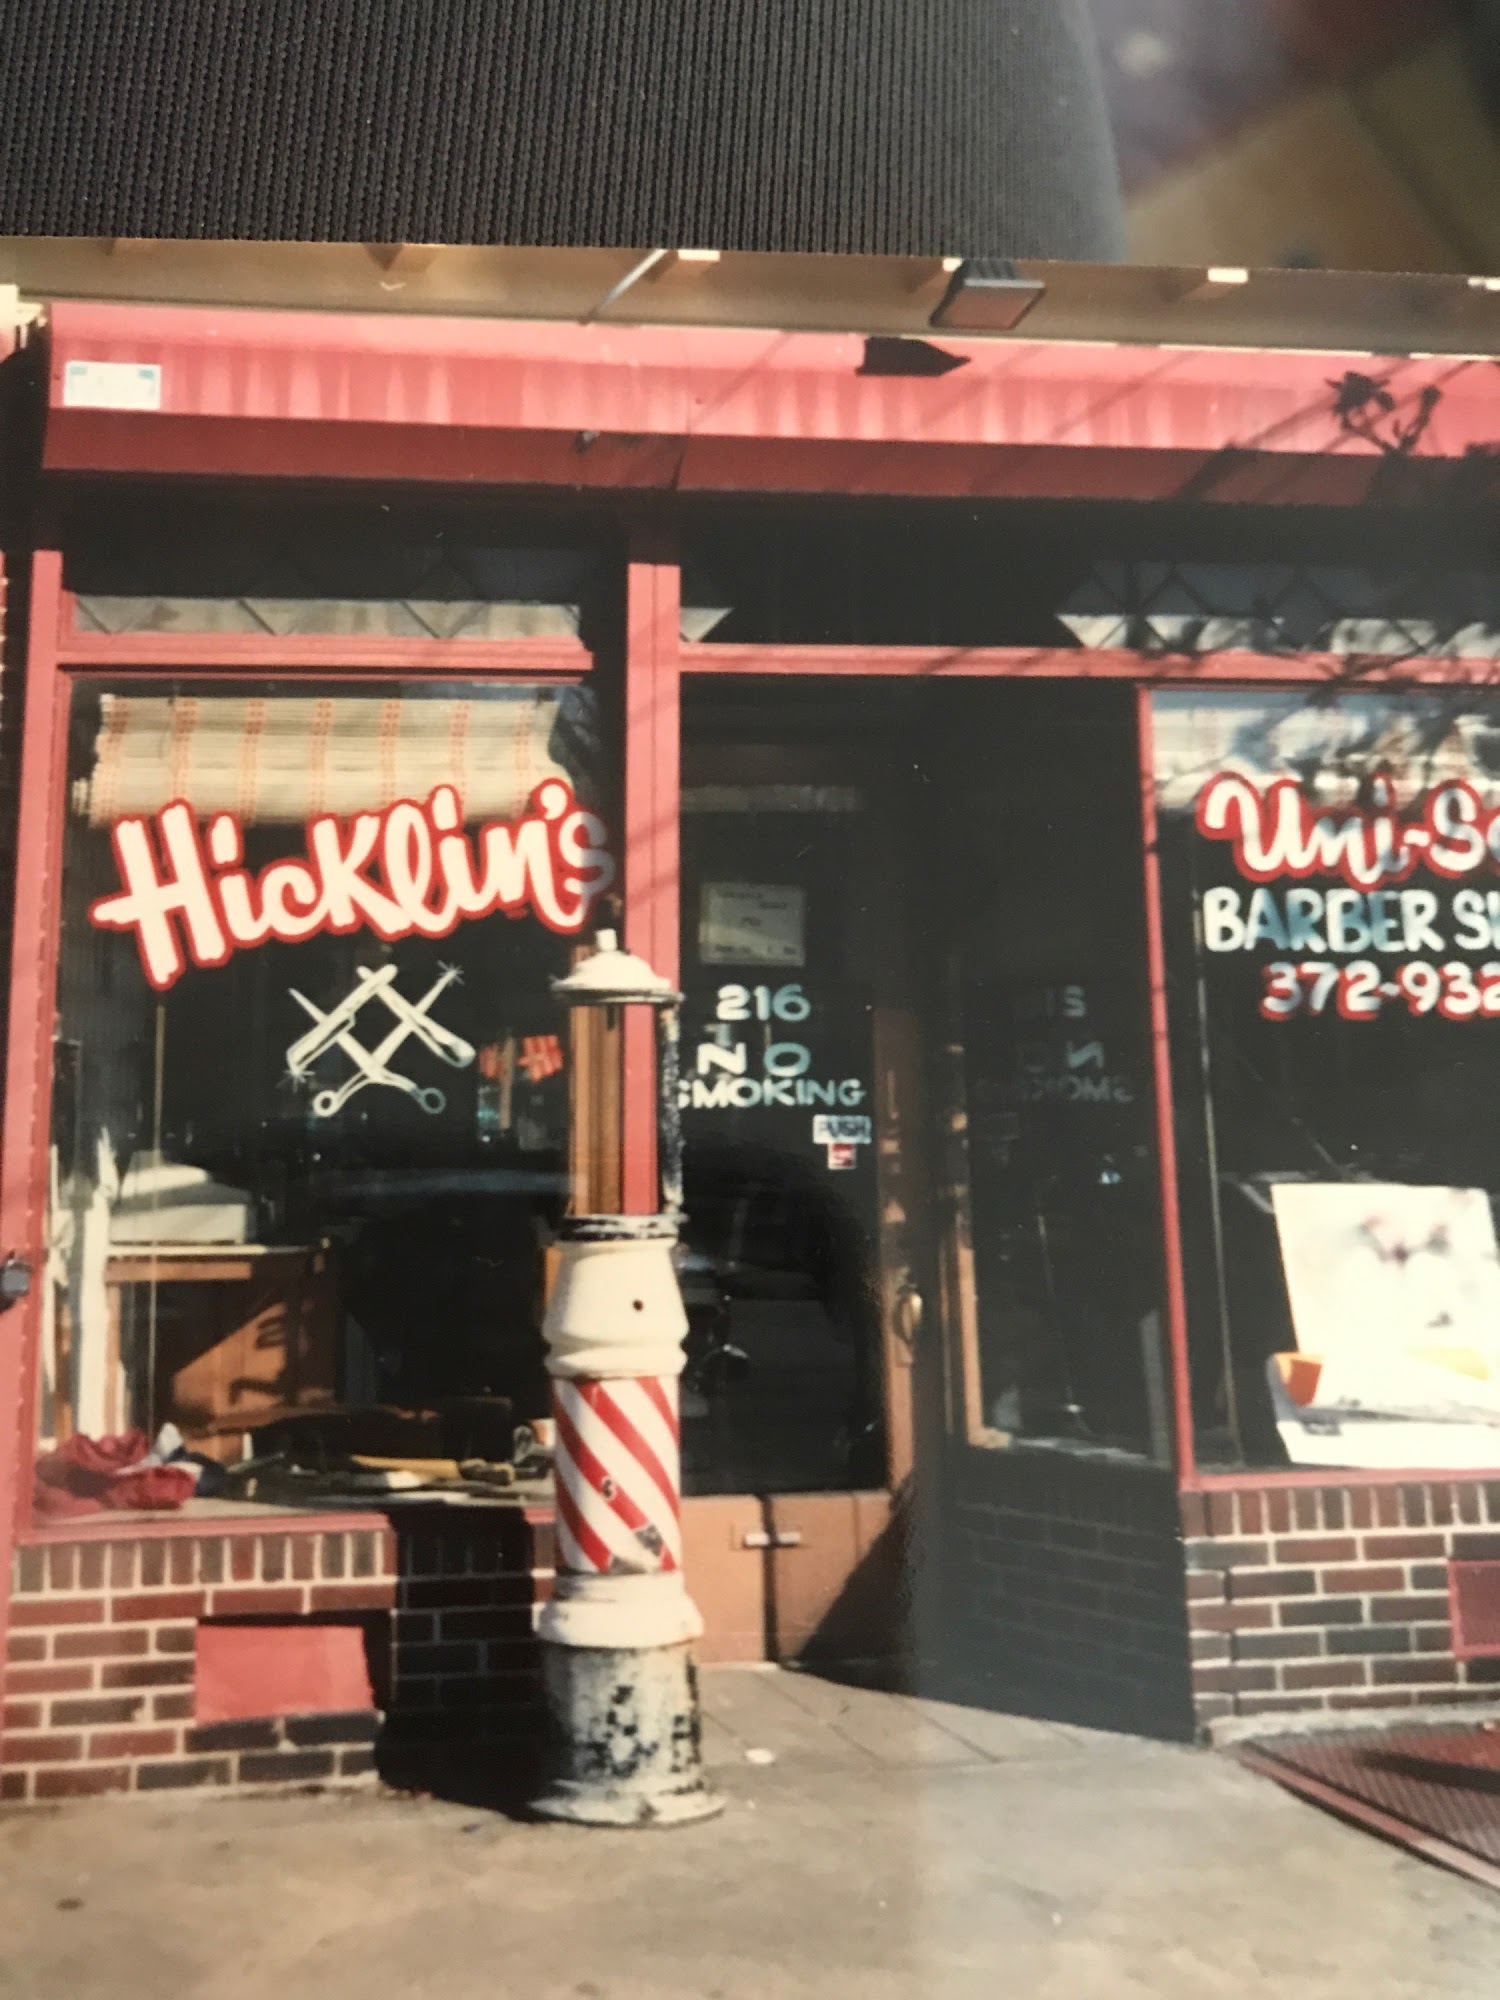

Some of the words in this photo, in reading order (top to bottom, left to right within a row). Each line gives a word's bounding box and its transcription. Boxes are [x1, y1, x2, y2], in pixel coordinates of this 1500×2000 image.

[90, 778, 614, 990] Hicklin's
[1203, 886, 1445, 953] BARBER
[716, 983, 811, 1021] 216
[697, 1042, 811, 1078] NO
